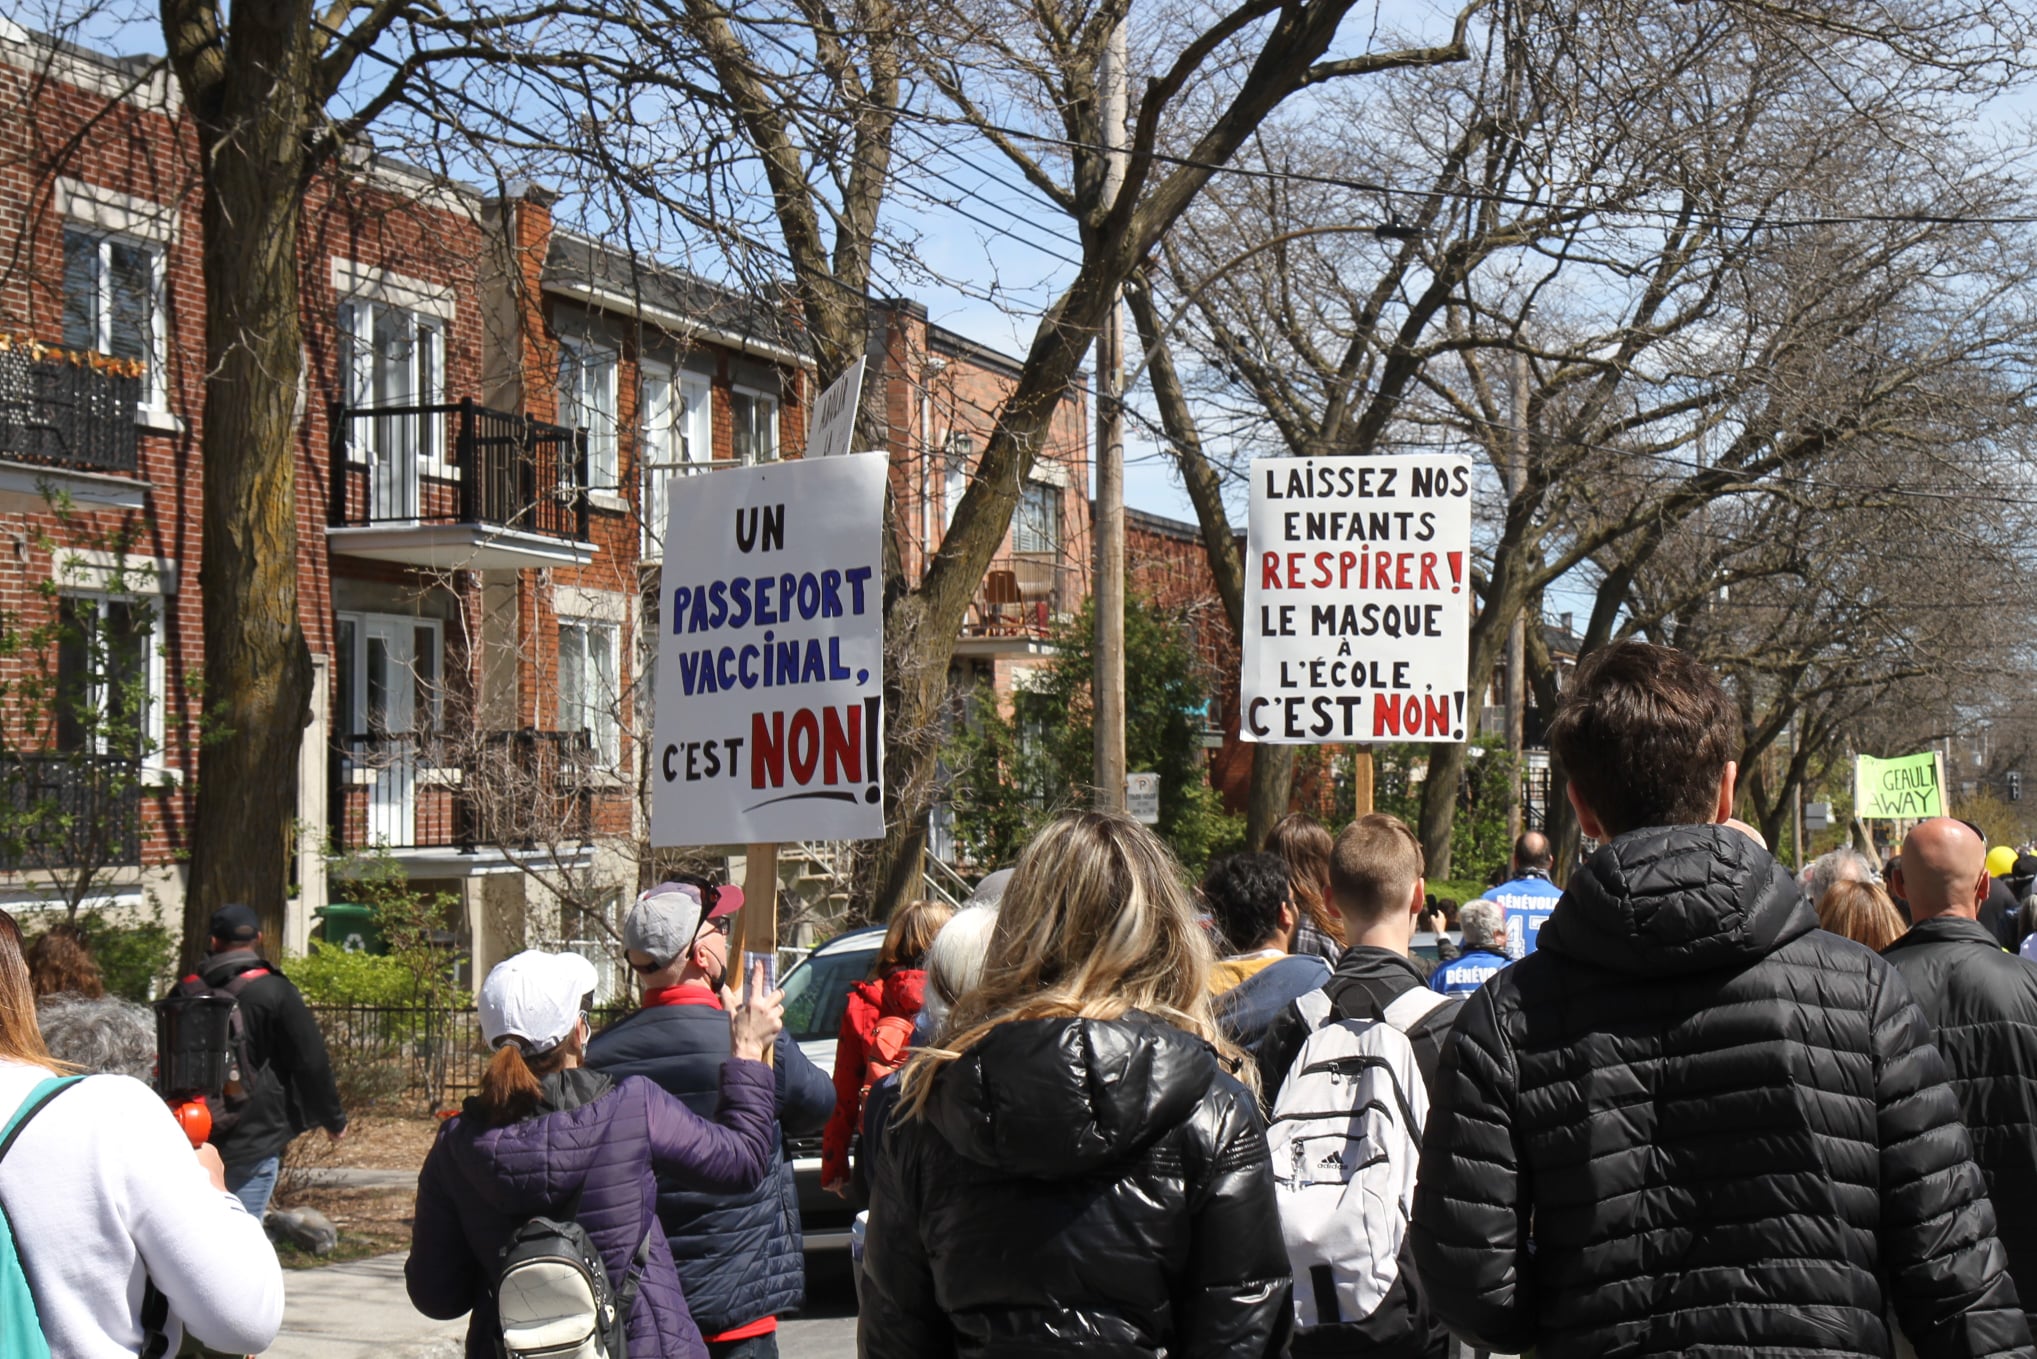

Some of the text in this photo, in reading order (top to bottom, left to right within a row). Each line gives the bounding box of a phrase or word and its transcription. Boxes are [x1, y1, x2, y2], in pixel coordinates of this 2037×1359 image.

[1411, 465, 1469, 498] NOS
[735, 503, 785, 553] UN
[1284, 512, 1436, 541] ENFANTS
[673, 566, 872, 635] PASSEPORT
[1261, 603, 1443, 639] LE MASQUE
[1337, 637, 1352, 656] À
[1249, 691, 1465, 740] C'EST NON!
[662, 695, 881, 804] C'EST NON!
[1865, 787, 1934, 814] AWAY
